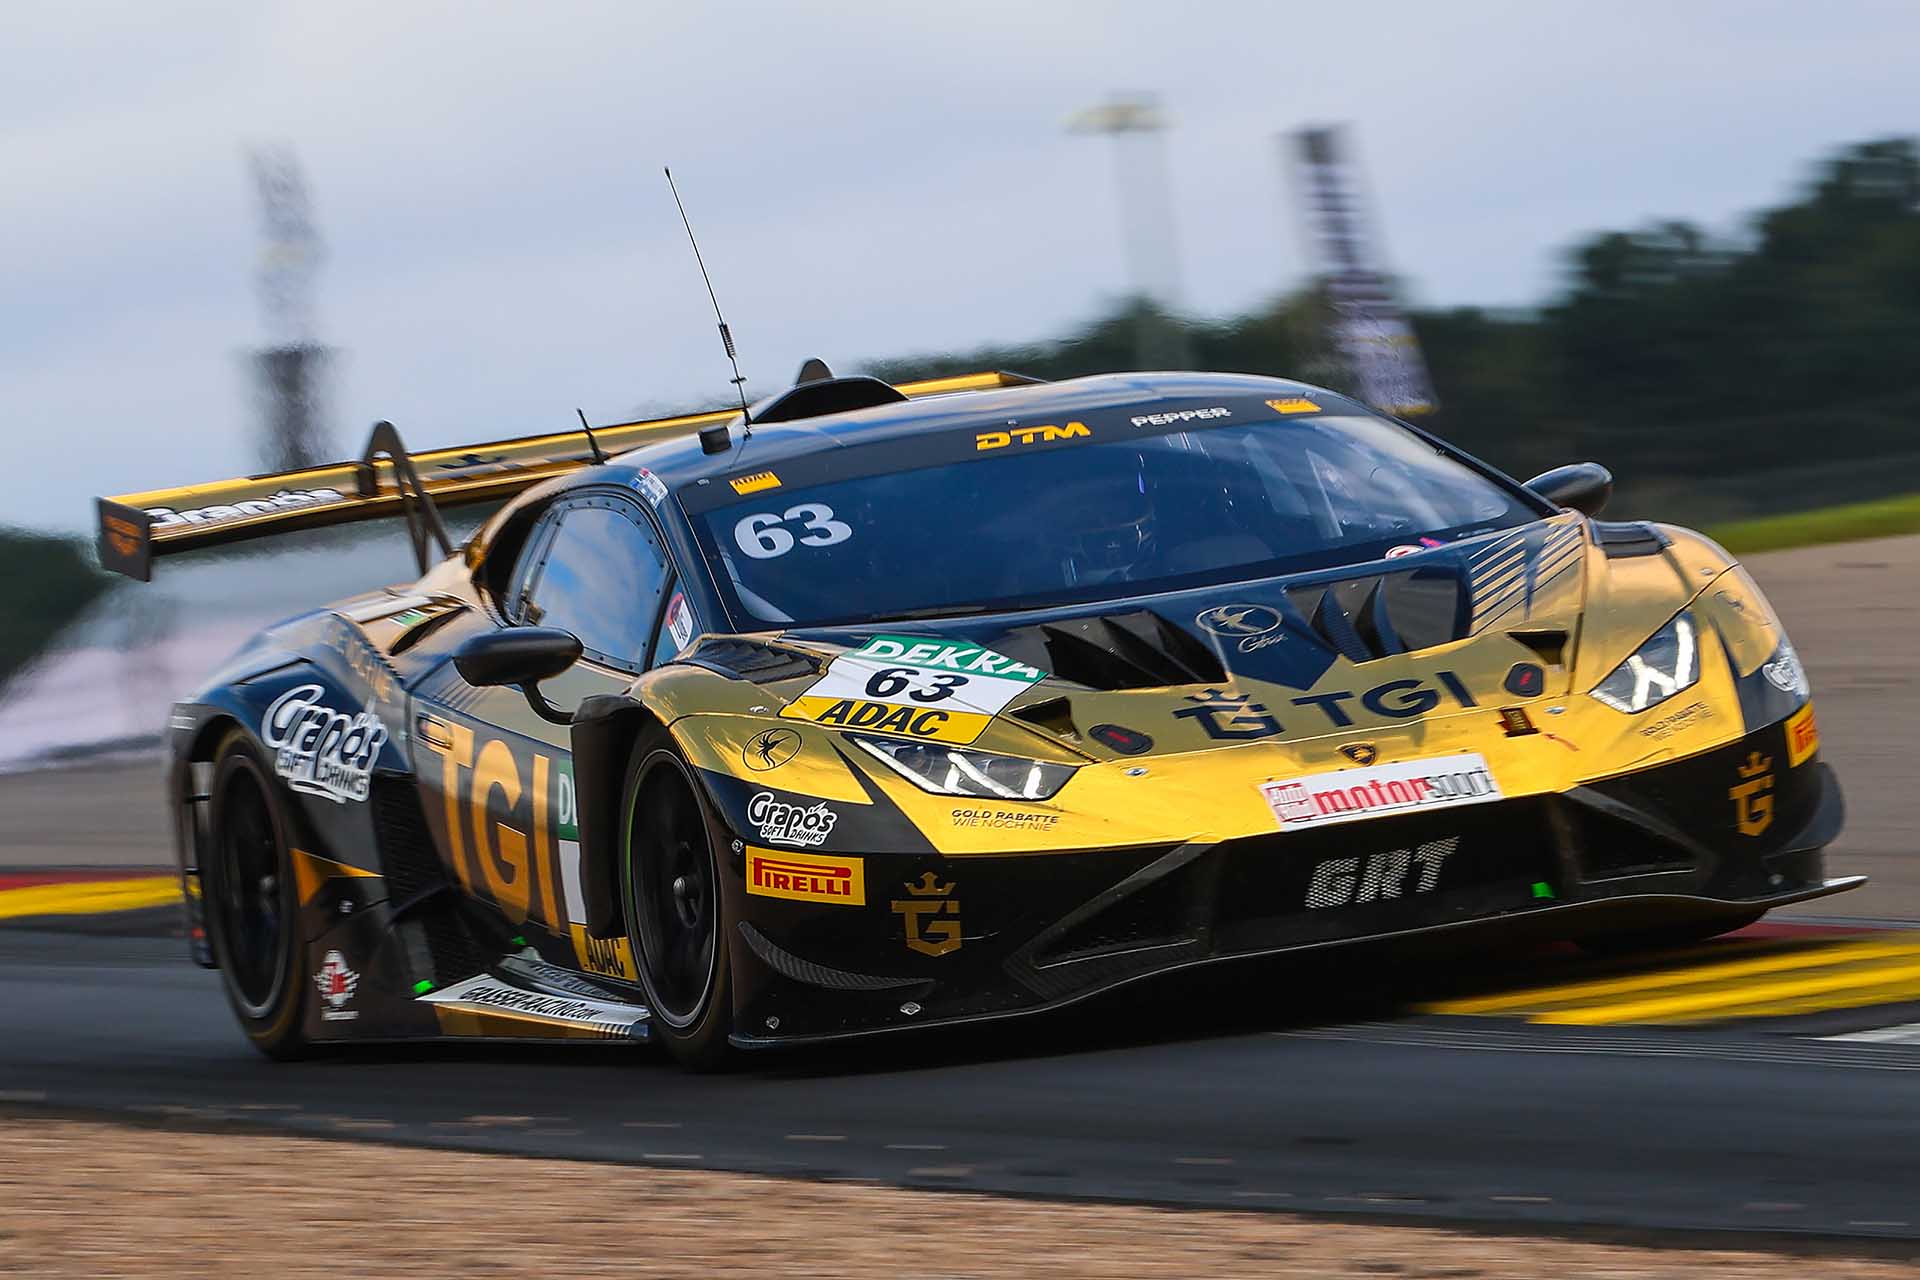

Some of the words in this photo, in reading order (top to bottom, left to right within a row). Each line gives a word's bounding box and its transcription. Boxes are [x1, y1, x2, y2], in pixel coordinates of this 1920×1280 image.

[1130, 406, 1233, 428] PEPPER
[975, 421, 1092, 451] DTM
[734, 502, 853, 560] 63
[855, 639, 1040, 679] DEKRA
[864, 667, 970, 703] 63
[1291, 671, 1480, 728] TGI
[816, 700, 950, 736] ADAC
[419, 713, 562, 937] TGI
[761, 824, 785, 837] SOFT
[789, 828, 826, 843] DRINKS
[952, 809, 992, 819] GOLD
[995, 811, 1059, 824] RABATTE
[953, 818, 977, 828] WIE
[982, 819, 1025, 830] NOCH
[1027, 822, 1052, 832] NIE
[753, 857, 852, 896] PIRELLI
[1304, 836, 1461, 909] GRT
